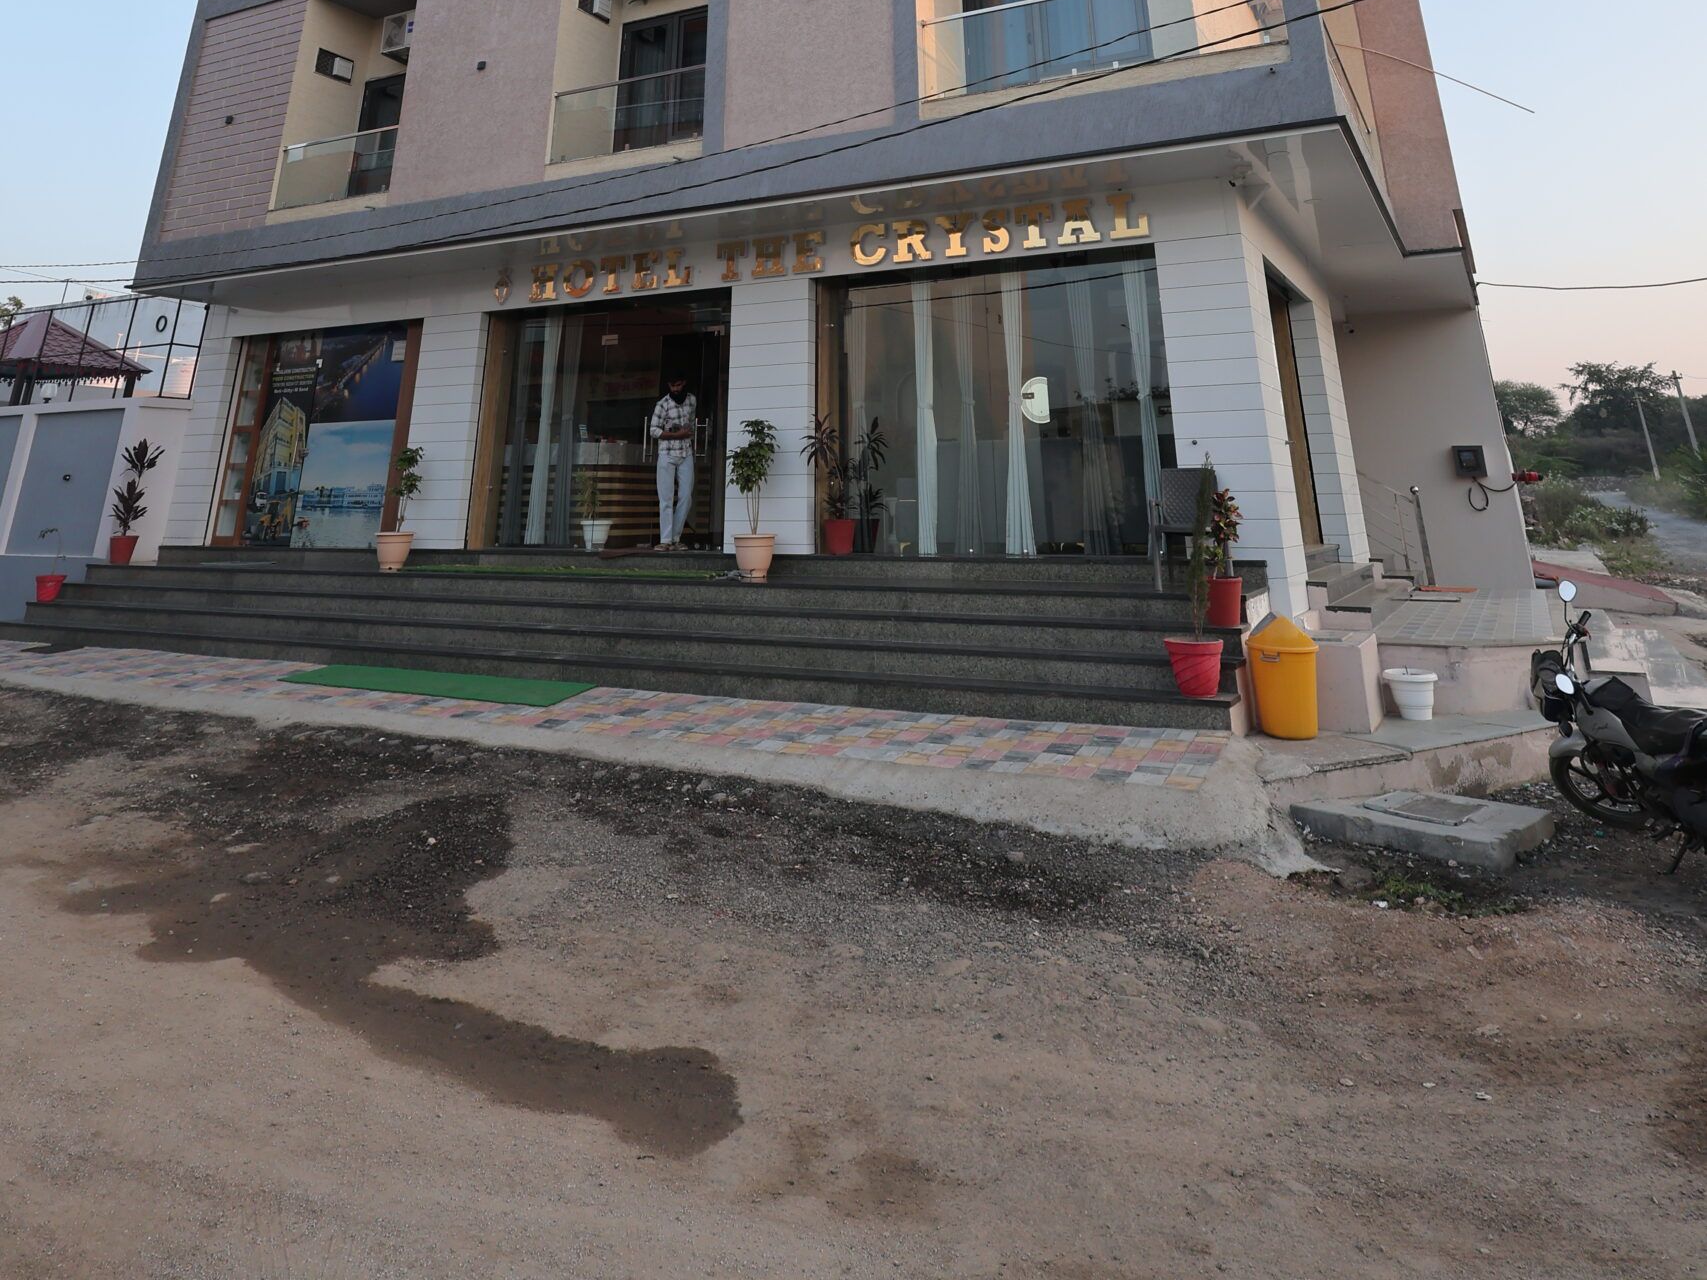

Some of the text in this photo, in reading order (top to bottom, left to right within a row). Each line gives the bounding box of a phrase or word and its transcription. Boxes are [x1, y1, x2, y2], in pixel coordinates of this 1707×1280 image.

[528, 192, 1151, 303] HOTEL THE CRYSTAL
